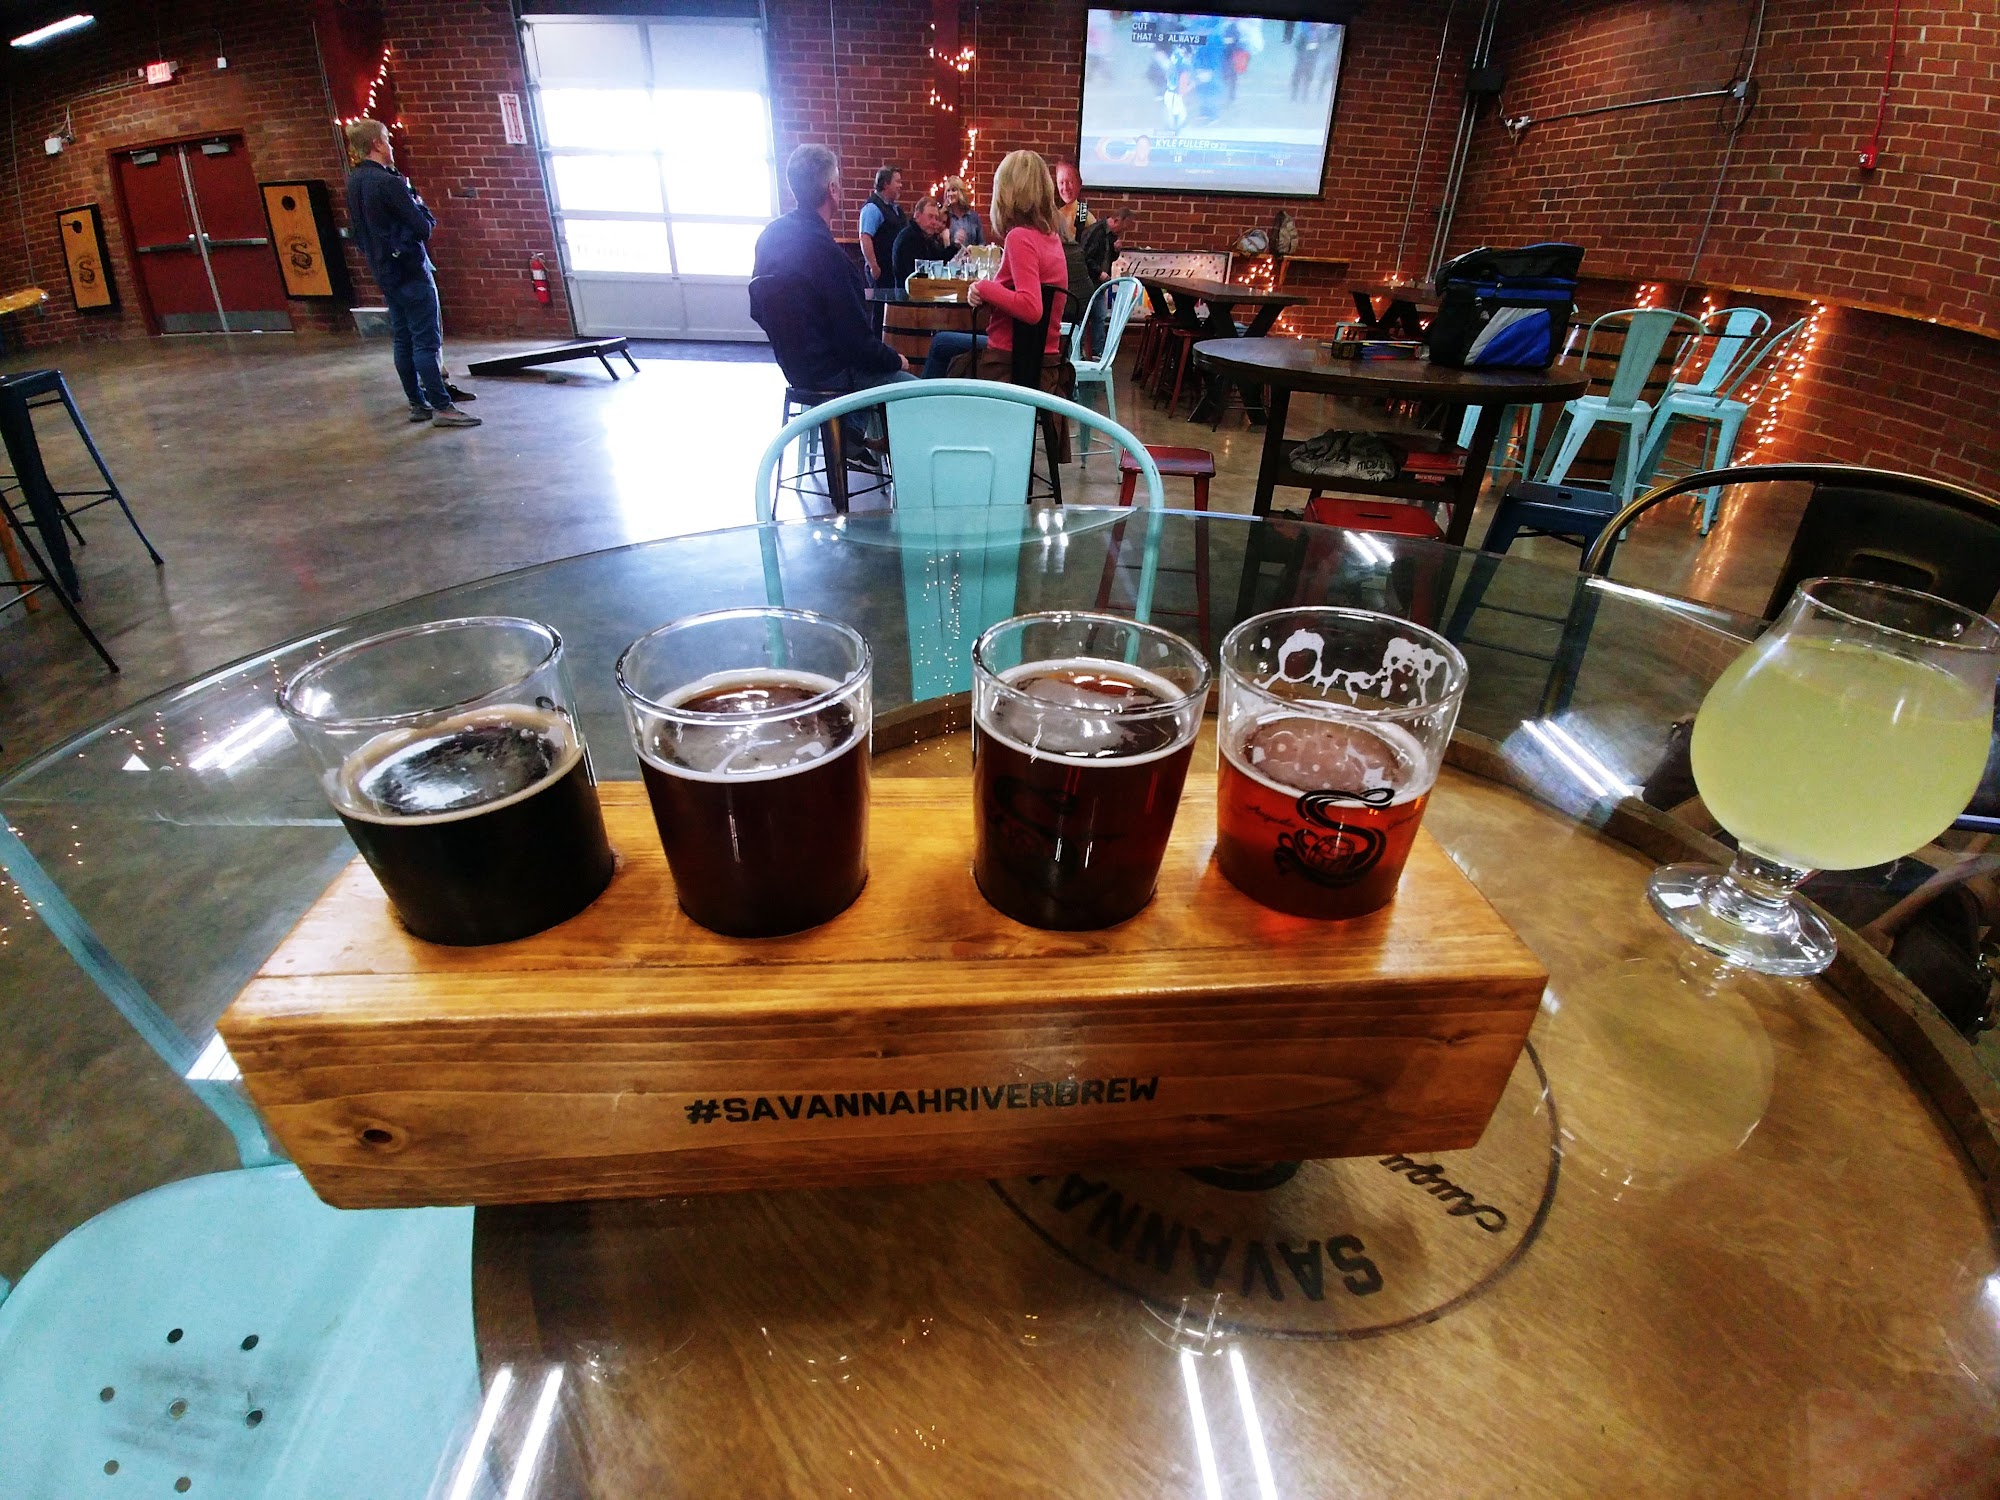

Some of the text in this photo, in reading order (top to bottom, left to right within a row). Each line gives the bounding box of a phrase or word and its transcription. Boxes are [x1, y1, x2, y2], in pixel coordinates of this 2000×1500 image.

[1132, 32, 1200, 44] THAT'S ALWAYS
[1155, 138, 1177, 148] KYLE
[1178, 139, 1210, 149] FULLER
[1126, 260, 1196, 279] Happy
[684, 1077, 1158, 1125] #SAVANNAHRIVERBREW
[1028, 1173, 1385, 1301] SAVANNA
